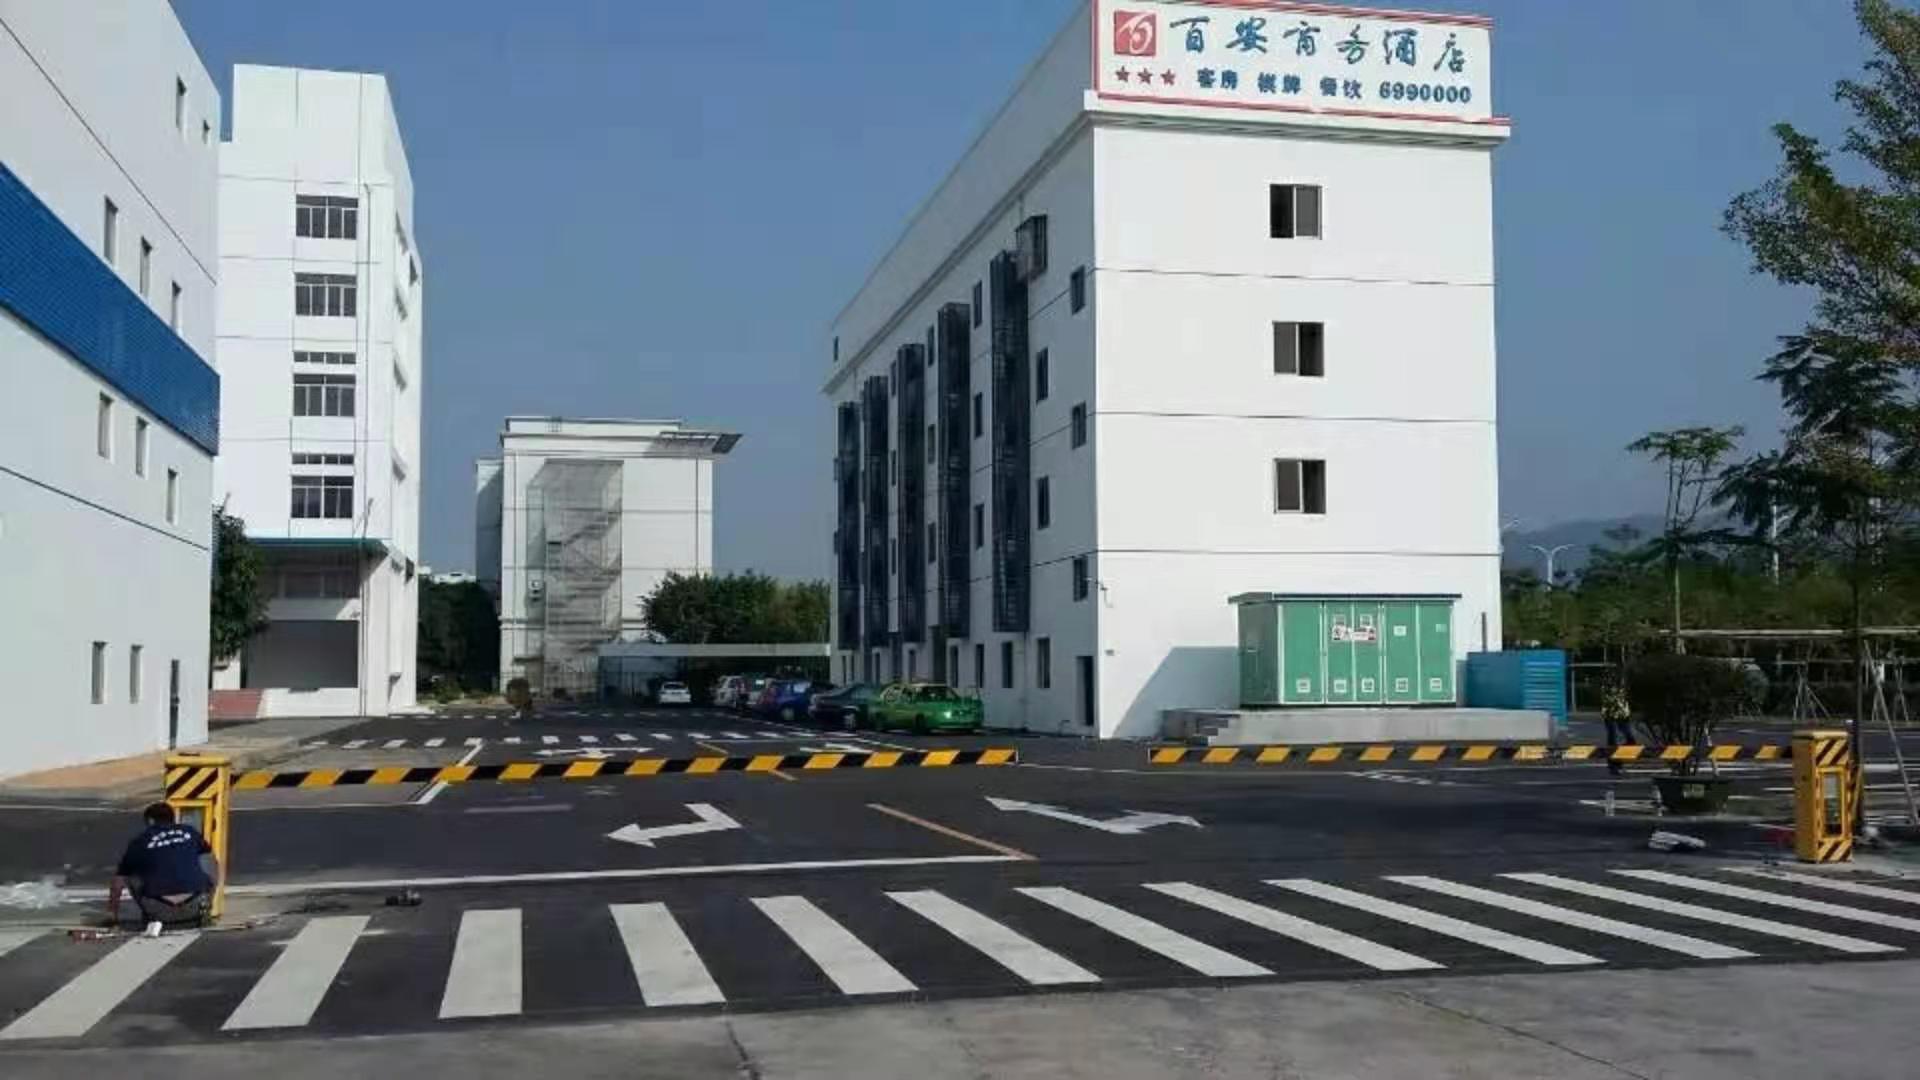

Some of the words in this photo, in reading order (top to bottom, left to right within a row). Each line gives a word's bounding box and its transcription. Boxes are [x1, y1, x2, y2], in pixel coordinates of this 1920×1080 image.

[1170, 15, 1464, 73] 百安商务酒店
[1197, 68, 1239, 90] 客房
[1257, 71, 1301, 95] 棋牌
[1319, 77, 1362, 99] 餐饮
